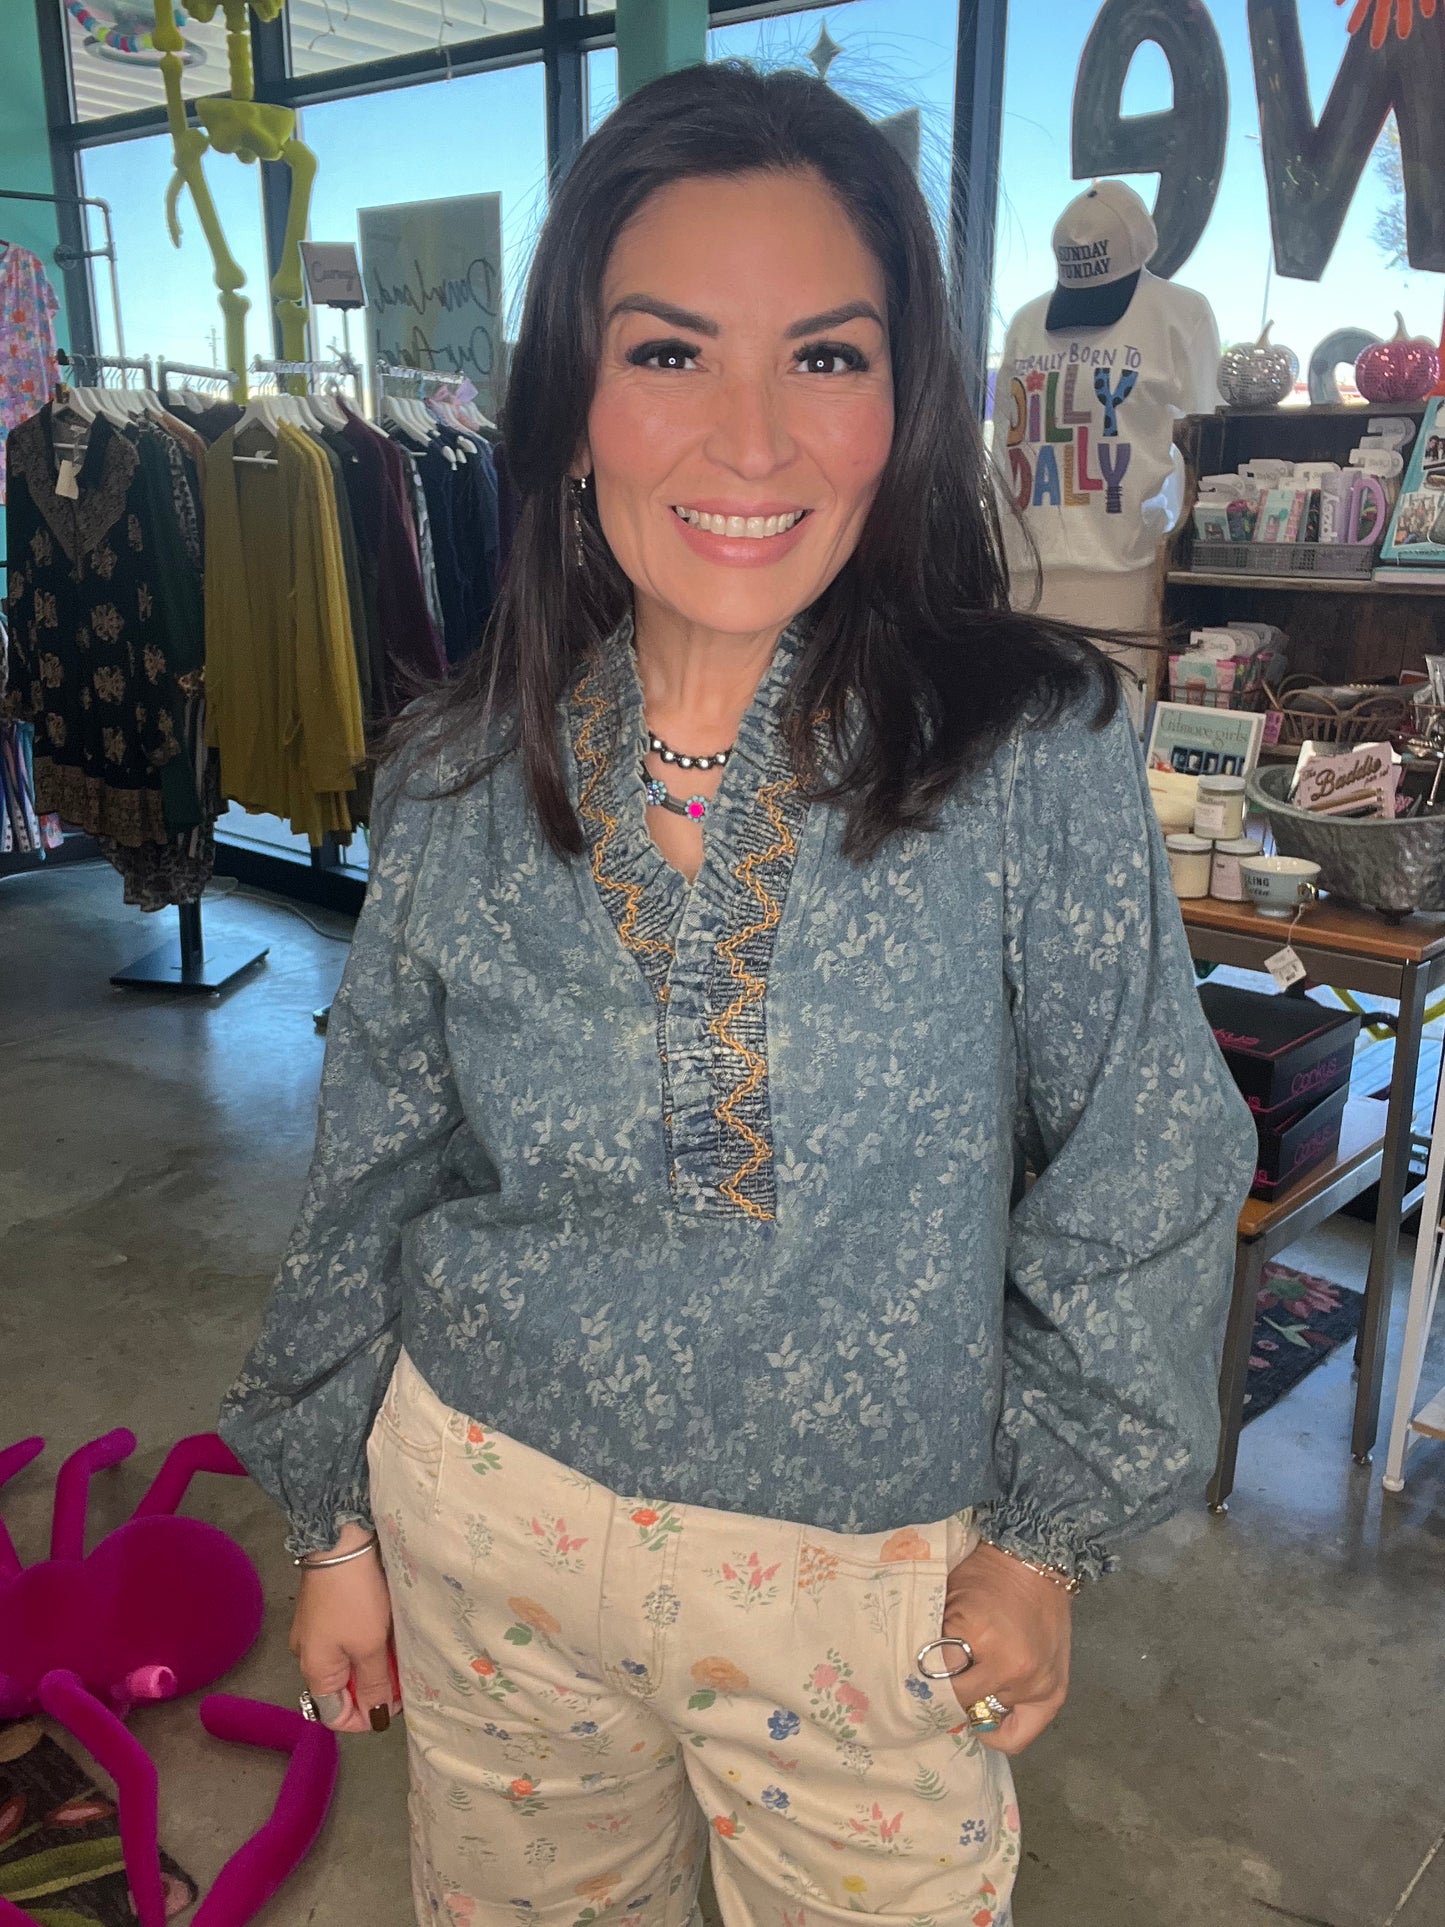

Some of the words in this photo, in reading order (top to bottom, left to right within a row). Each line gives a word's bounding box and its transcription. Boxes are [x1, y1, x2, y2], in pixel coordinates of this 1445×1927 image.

[1059, 239, 1109, 262] SUNDAY
[1068, 342, 1117, 367] BORN
[1123, 344, 1142, 369] TO
[1007, 440, 1132, 514] DALLY
[1160, 708, 1213, 738] Gilmore
[1212, 720, 1250, 750] girls
